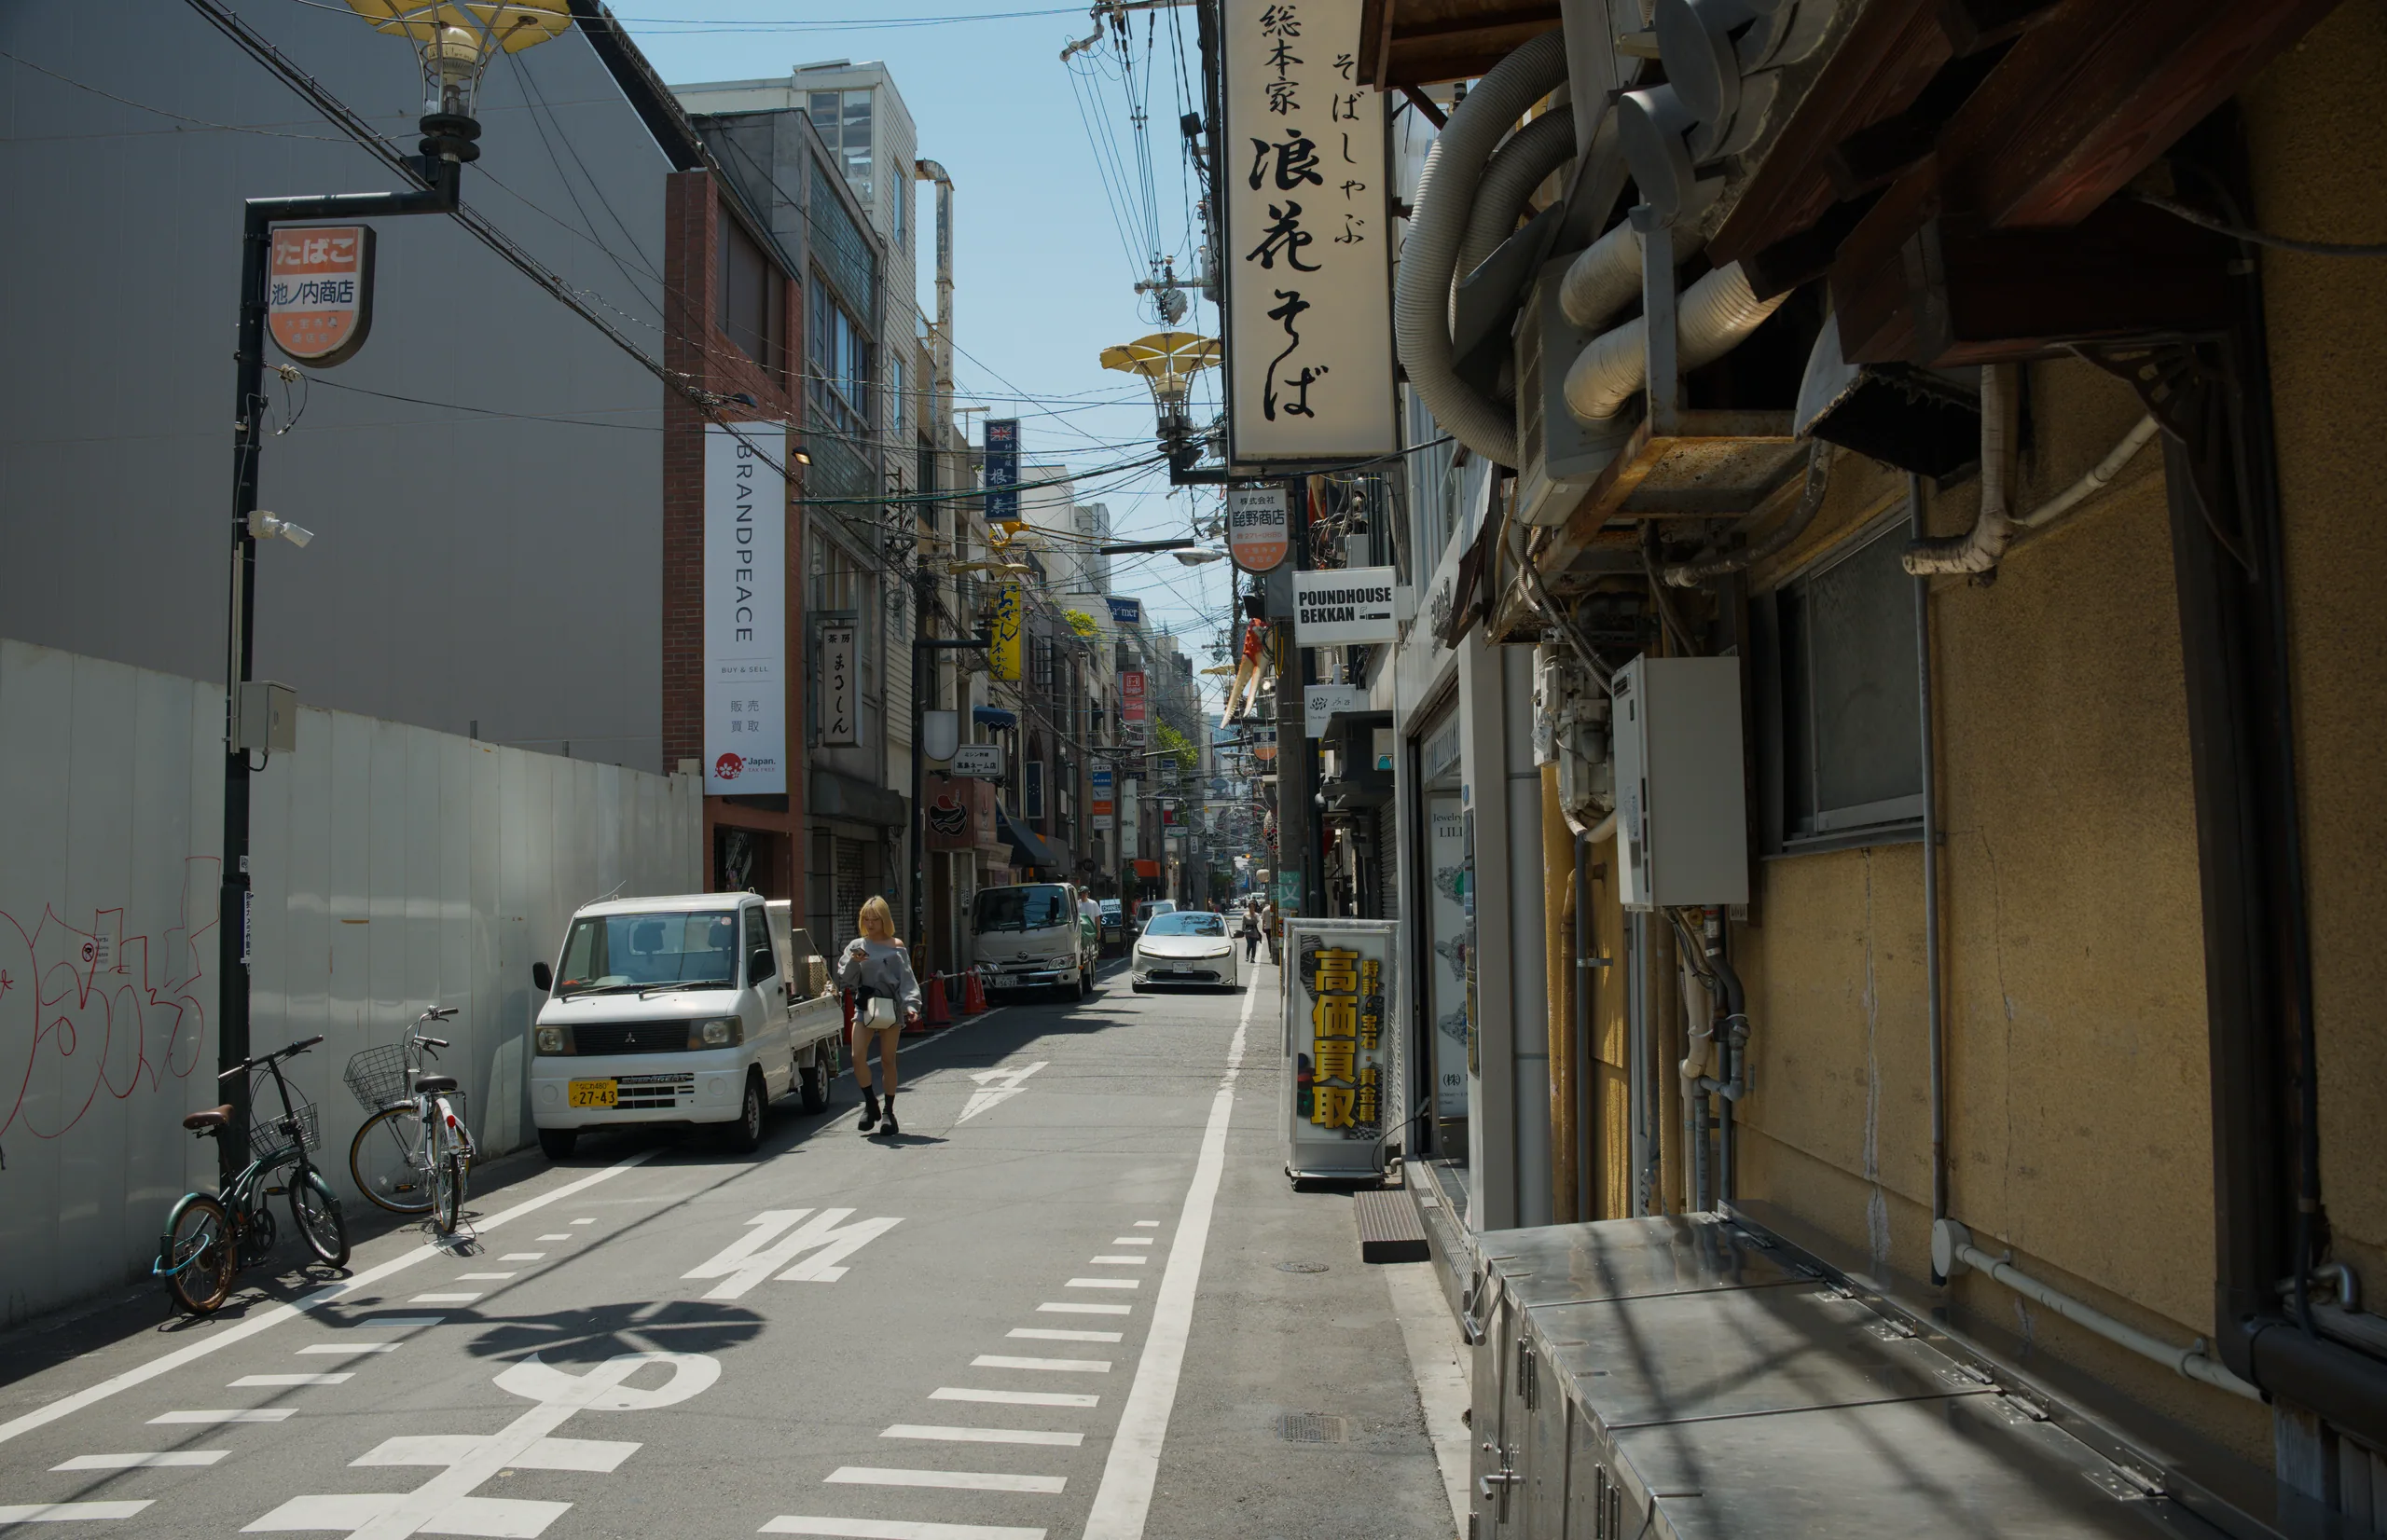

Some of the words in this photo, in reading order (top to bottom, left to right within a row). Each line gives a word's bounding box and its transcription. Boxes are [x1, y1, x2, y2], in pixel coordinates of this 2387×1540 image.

[1331, 53, 1366, 245] そばしゃぶ
[276, 238, 354, 266] たばこ
[270, 279, 354, 306] 池ノ内商店
[1239, 495, 1276, 506] 株式会社
[1232, 509, 1285, 528] 鹿野商店
[735, 443, 753, 644] BRANDPEACE
[1298, 586, 1392, 607] POUNDHOUSE
[1300, 606, 1355, 624] BEKKAN
[827, 633, 850, 644] 茶房
[832, 653, 849, 735] まるしん
[730, 700, 760, 712] 販売
[731, 720, 760, 733] 買取
[748, 757, 776, 766] Japan.
[1432, 812, 1463, 823] Jewelry
[1310, 946, 1359, 1130] 高価買取
[1359, 958, 1380, 1123] 時計・宝石・貴金属
[579, 1091, 615, 1105] 27-43
